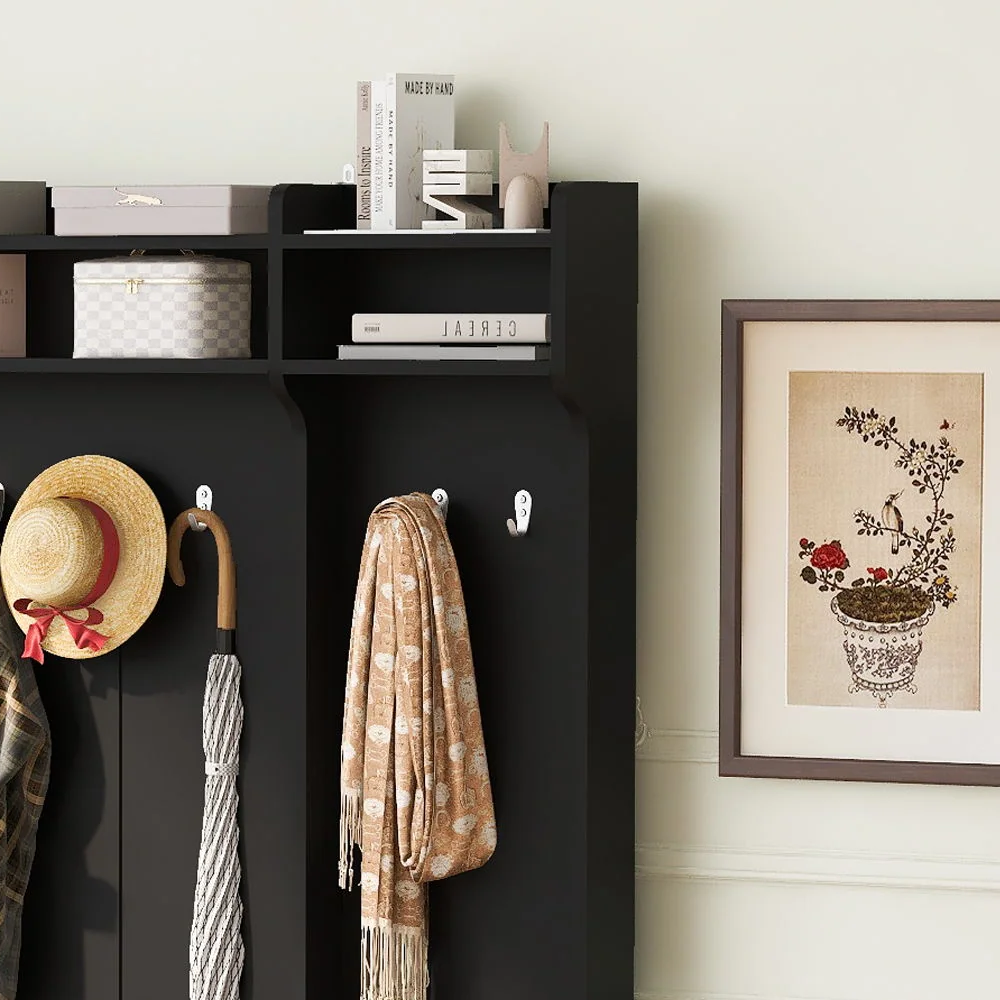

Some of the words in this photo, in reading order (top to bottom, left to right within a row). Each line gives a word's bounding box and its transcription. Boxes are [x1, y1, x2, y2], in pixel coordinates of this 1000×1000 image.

[405, 81, 423, 94] MADE
[425, 82, 433, 95] BY
[435, 83, 453, 95] HAND
[389, 143, 393, 157] BY
[357, 147, 371, 177] Inspire
[375, 155, 383, 175] HOME
[359, 179, 371, 188] to
[358, 190, 371, 221] Rooms
